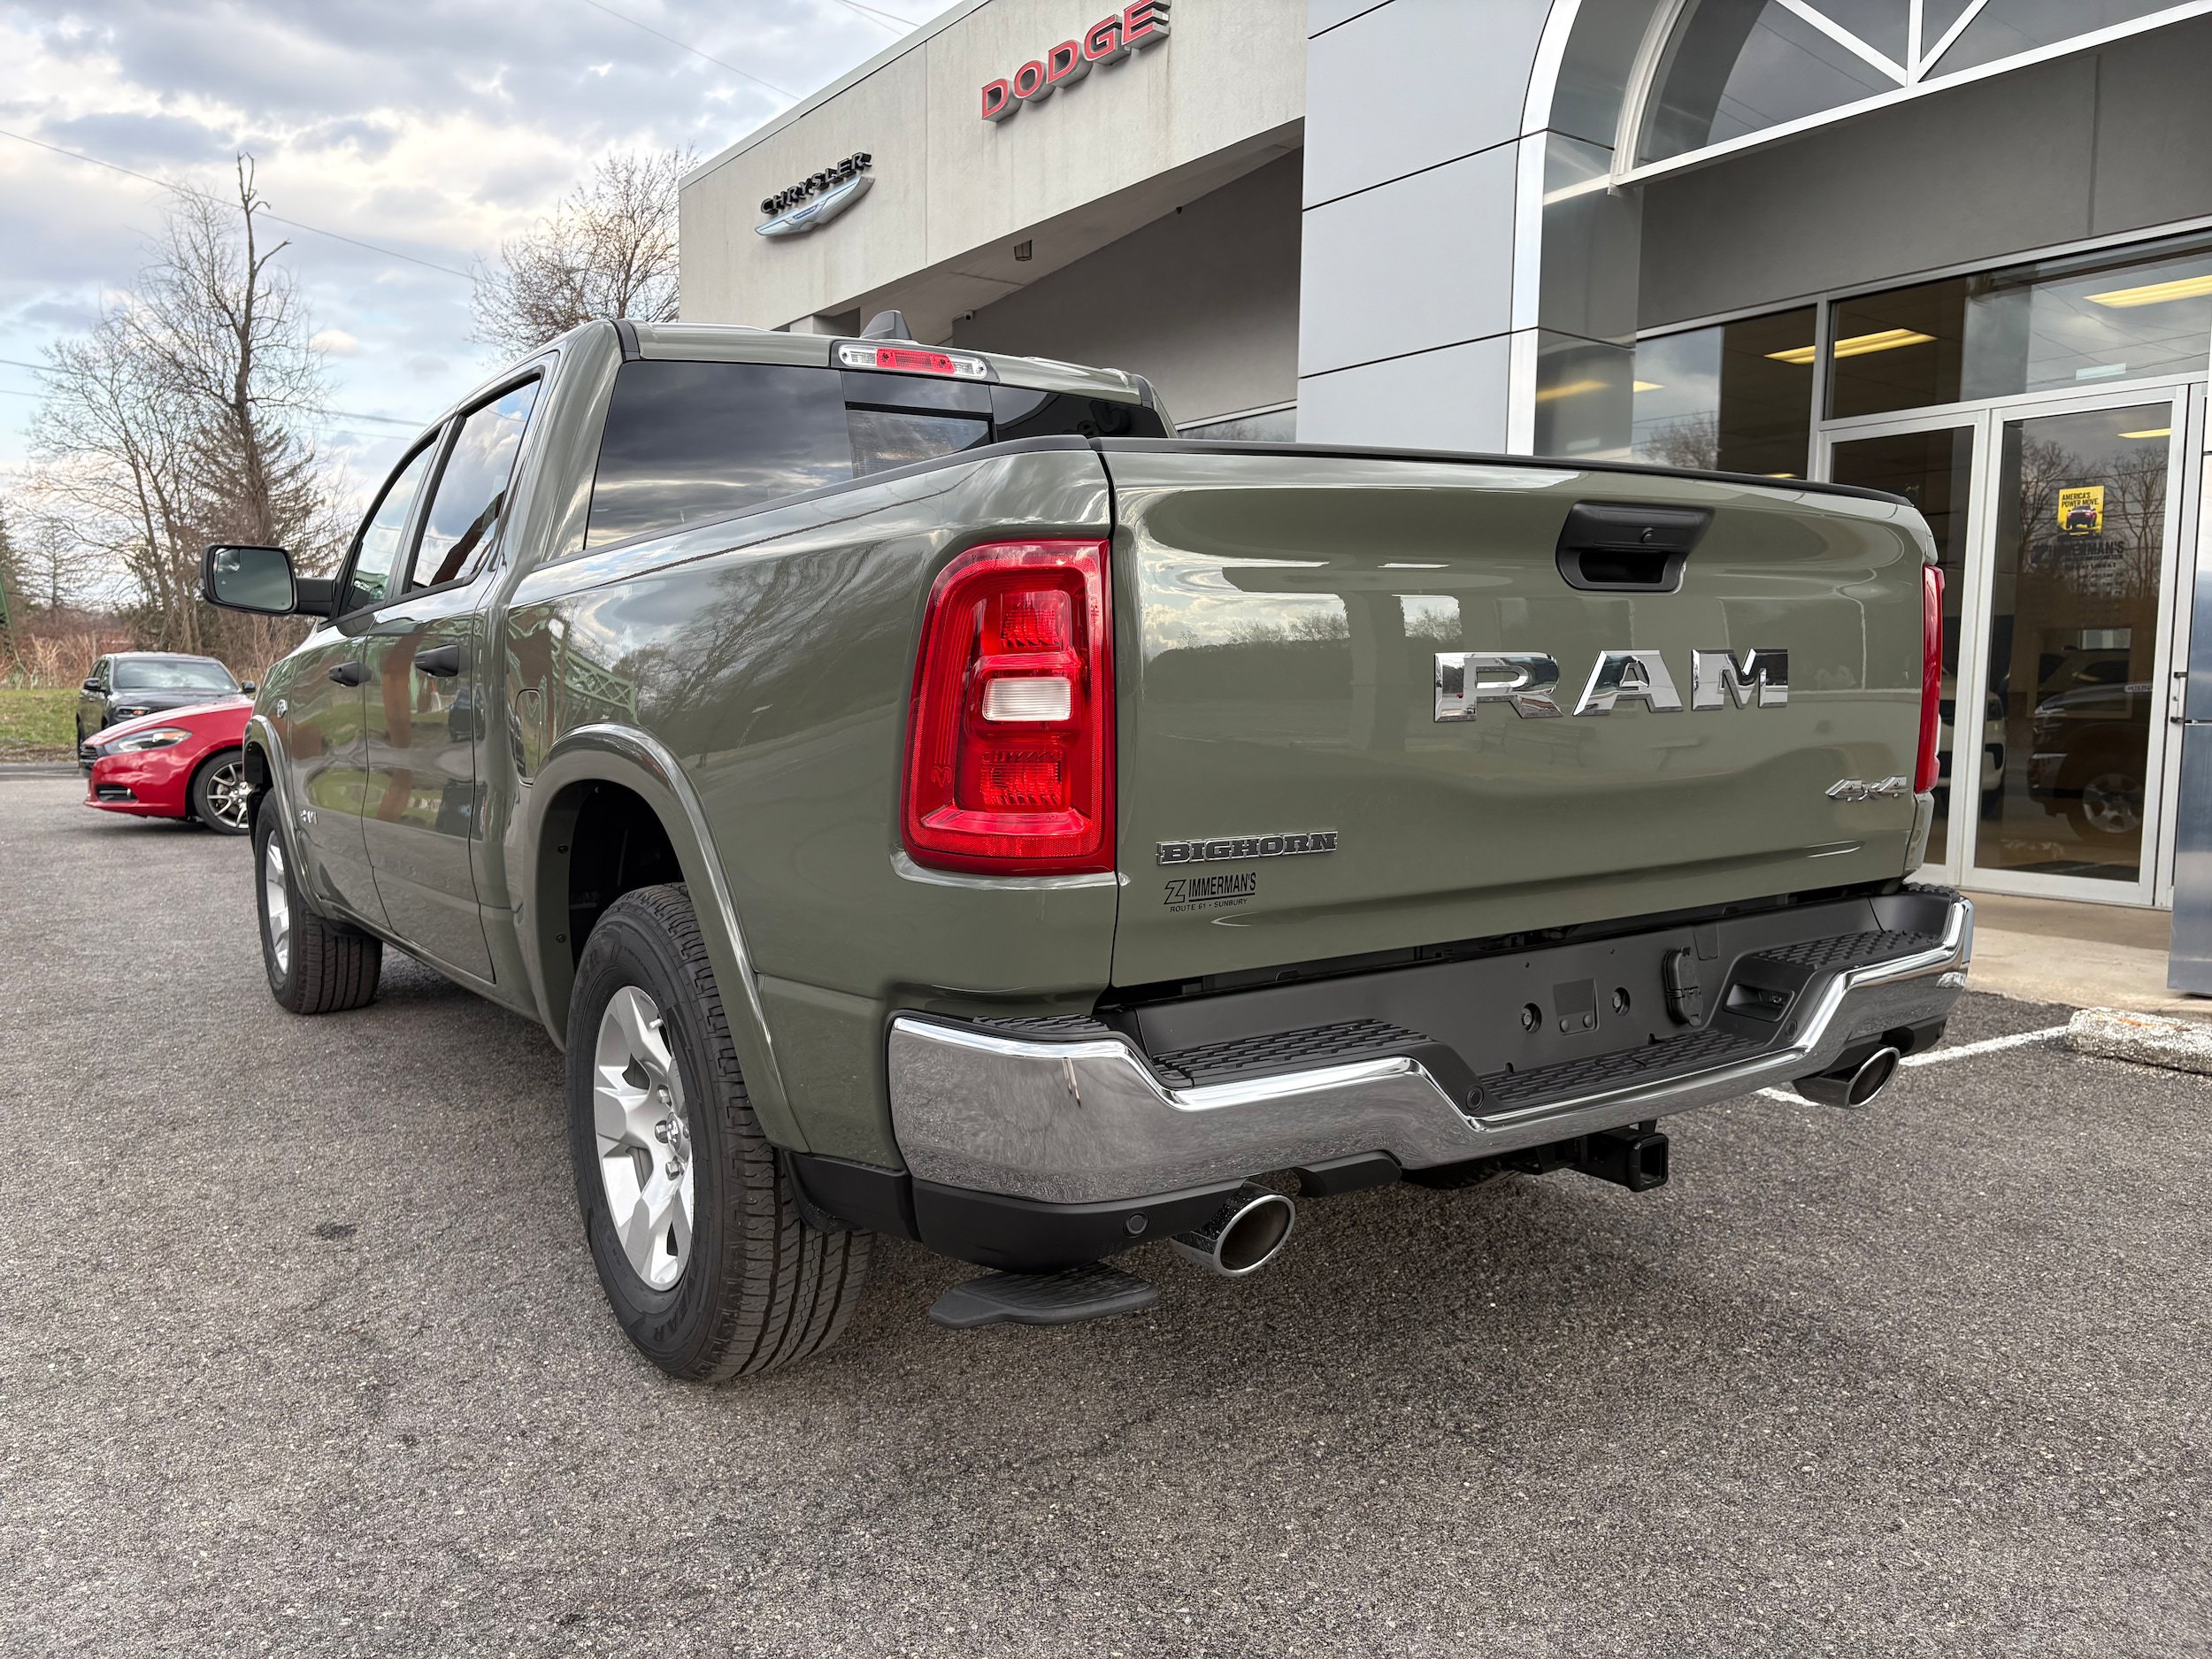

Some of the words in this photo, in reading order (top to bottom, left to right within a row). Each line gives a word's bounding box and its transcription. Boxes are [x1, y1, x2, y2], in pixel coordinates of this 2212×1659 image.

[981, 0, 1163, 120] DODGE
[761, 152, 870, 213] CHRYSLER
[2062, 492, 2091, 501] AMERICA'S
[2062, 499, 2081, 508] POWER
[2082, 497, 2100, 506] MOVE.
[2031, 541, 2124, 565] ZIEMAN'S
[1432, 649, 1789, 723] RAM
[1156, 831, 1339, 865] BIGHORN
[1164, 872, 1256, 905] ZIMMERMAN'S
[1170, 904, 1196, 913] ROUTE
[1214, 898, 1248, 908] SUNBURY
